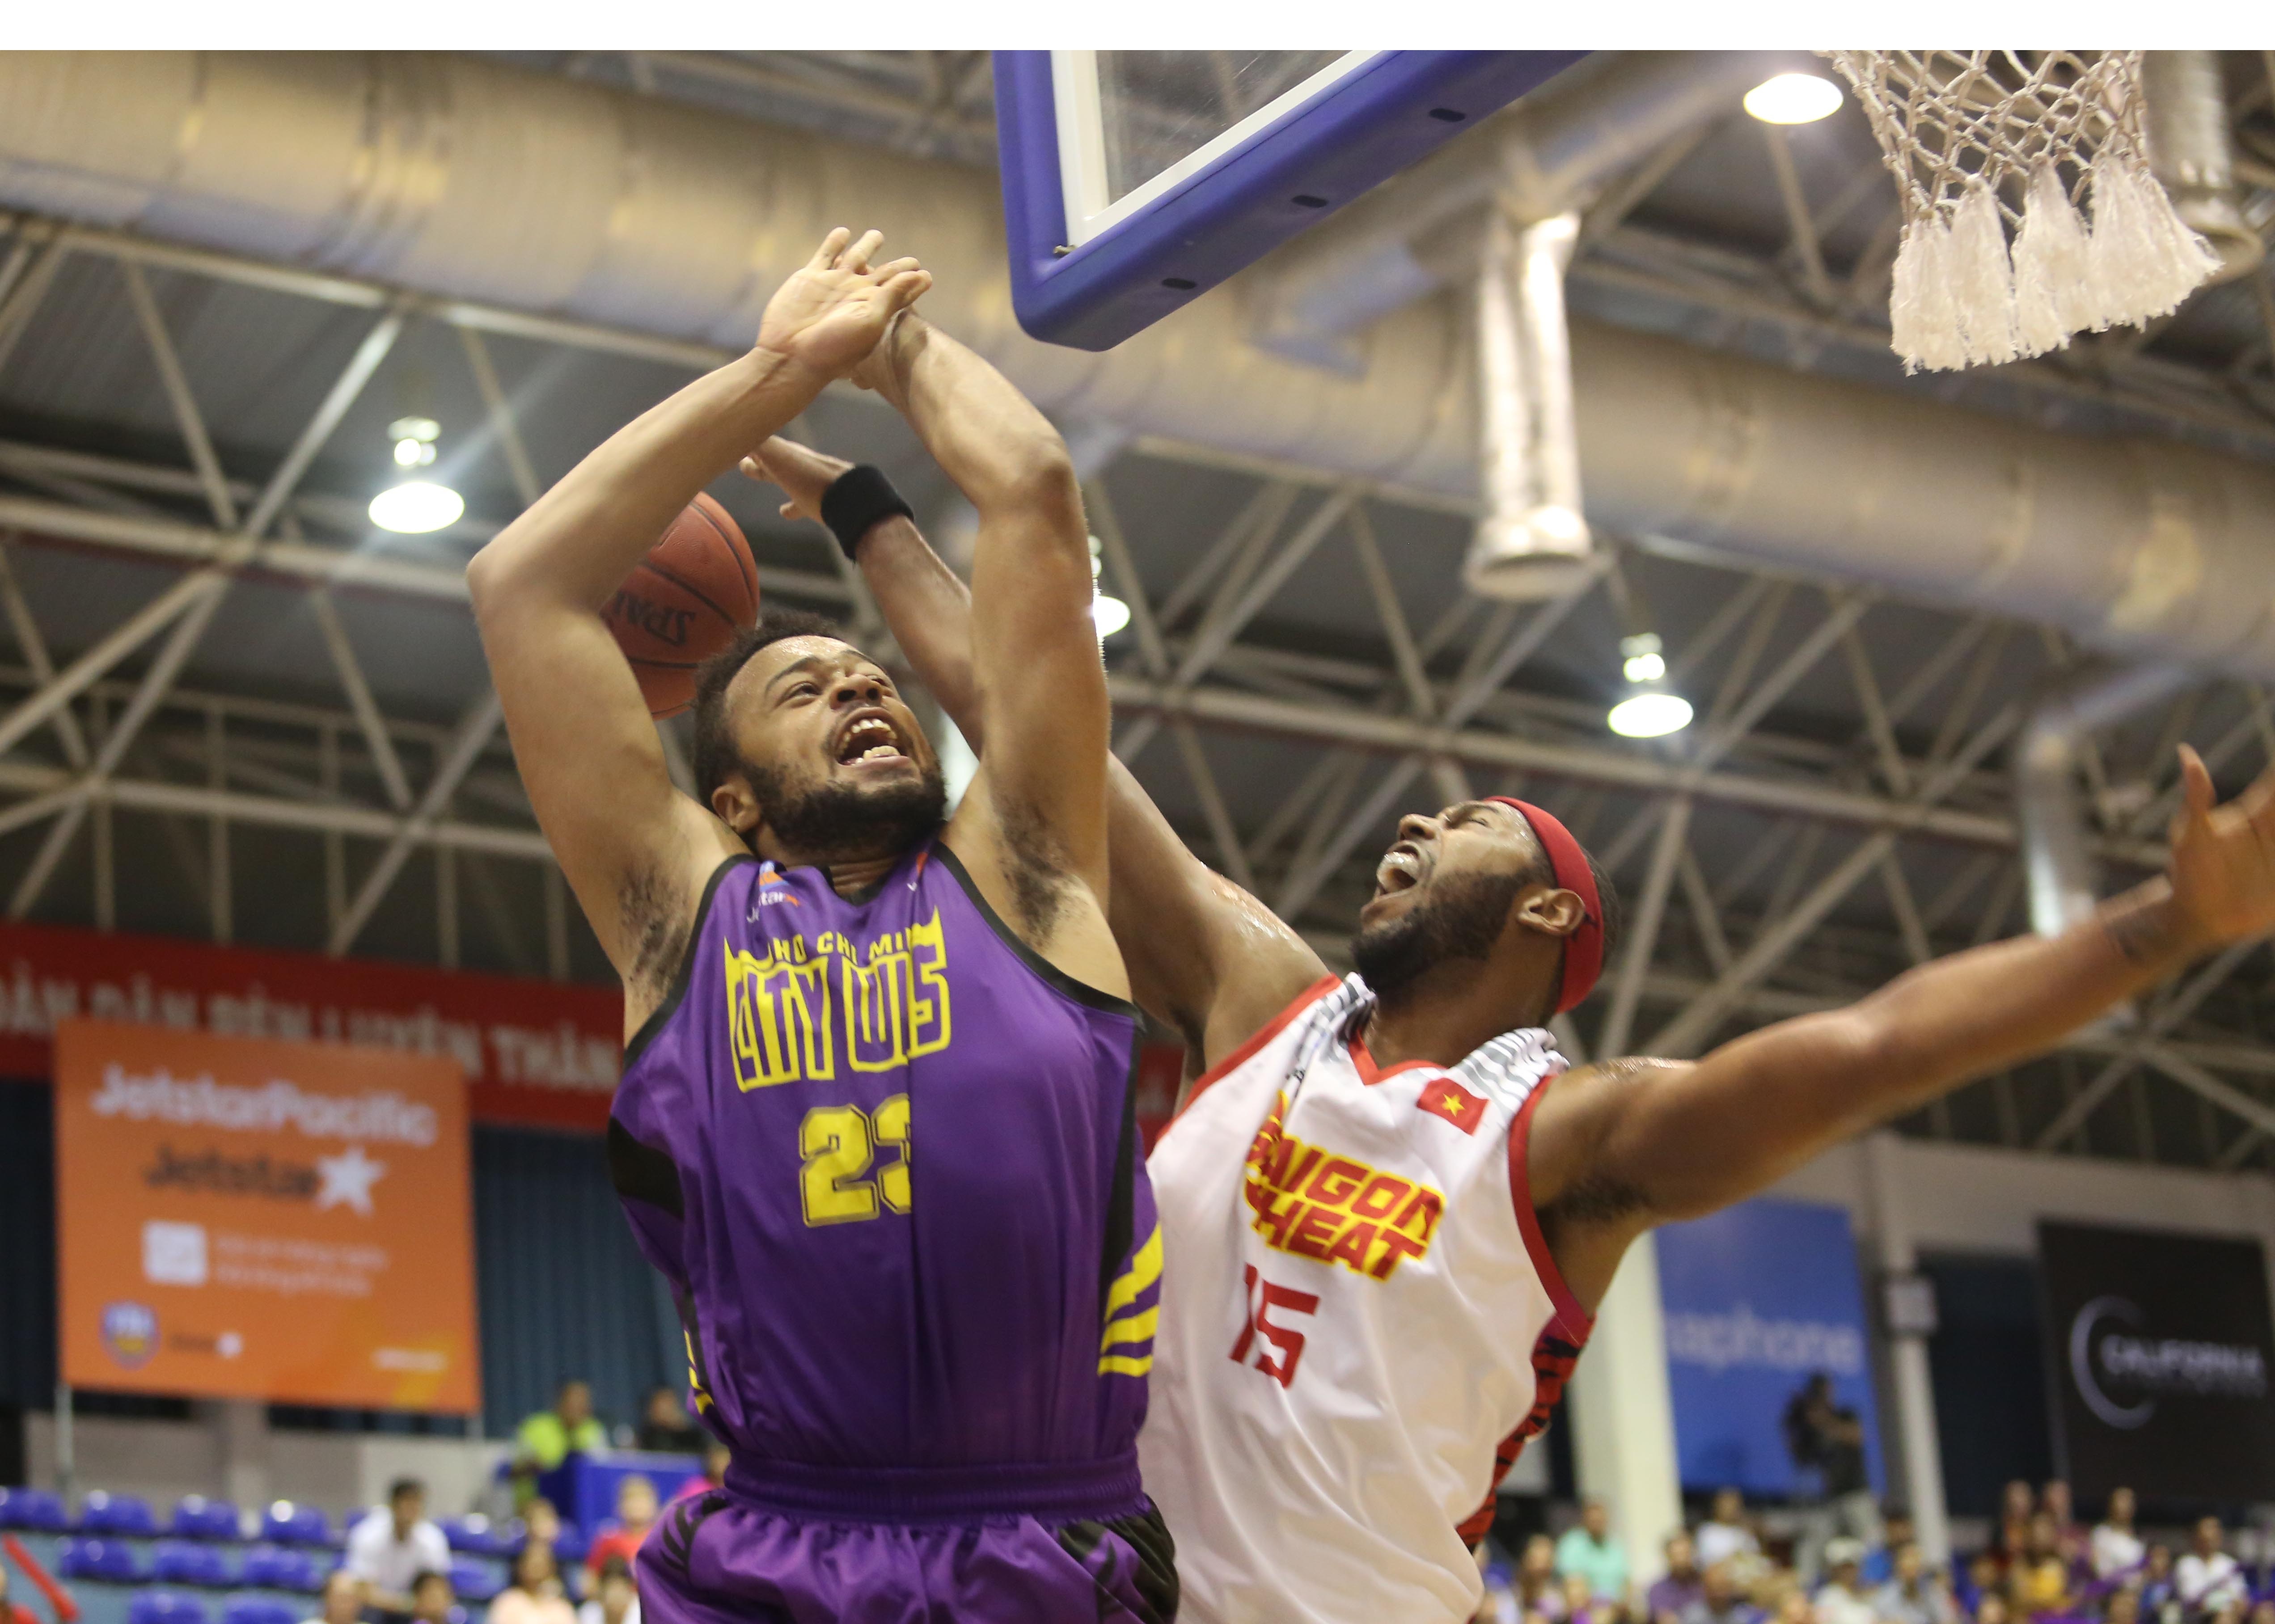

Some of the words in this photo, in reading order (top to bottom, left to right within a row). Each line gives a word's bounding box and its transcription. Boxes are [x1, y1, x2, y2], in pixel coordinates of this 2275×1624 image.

[773, 934, 807, 964] HO
[816, 931, 858, 965] CHI
[799, 1093, 912, 1228] 23
[1253, 1183, 1429, 1282] HEAT
[1229, 1263, 1320, 1389] 15
